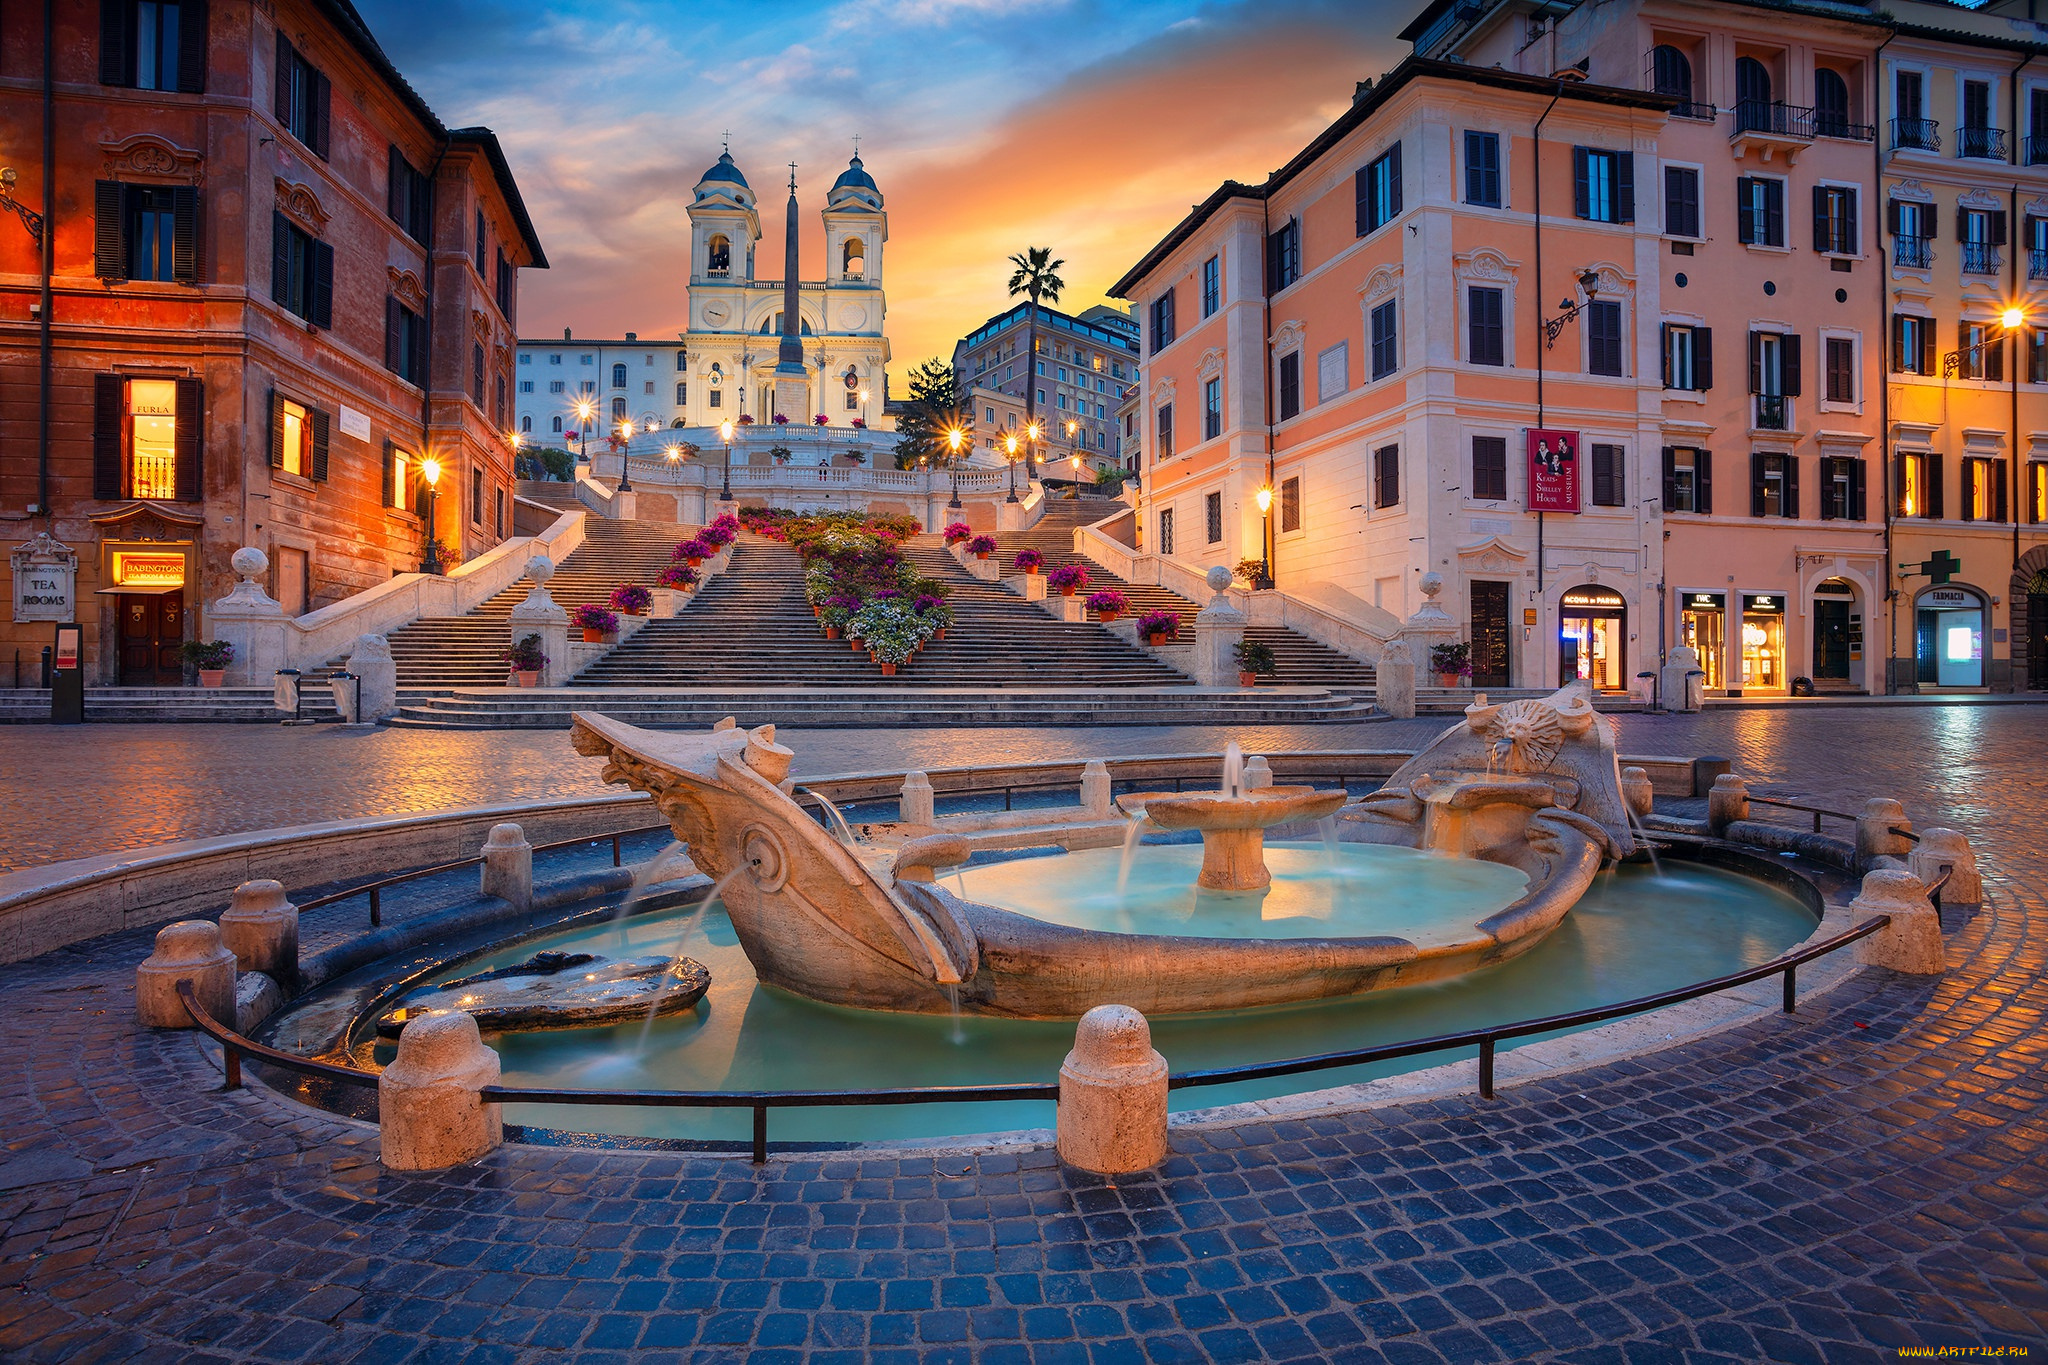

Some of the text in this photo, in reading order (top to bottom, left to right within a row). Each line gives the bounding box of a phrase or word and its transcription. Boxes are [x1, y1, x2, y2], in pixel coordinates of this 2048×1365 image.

[137, 406, 169, 414] FURLA
[1536, 483, 1562, 492] SHELLEY
[1536, 493, 1557, 503] HOUSE
[127, 565, 184, 573] BABINGTONS
[31, 580, 57, 590] TEA
[23, 595, 65, 606] ROOMS
[1564, 596, 1589, 604] ACQUA
[1596, 597, 1621, 605] PARMA
[1696, 594, 1712, 603] IWC
[1756, 596, 1772, 605] IWC
[1932, 592, 1965, 601] FARMACIA
